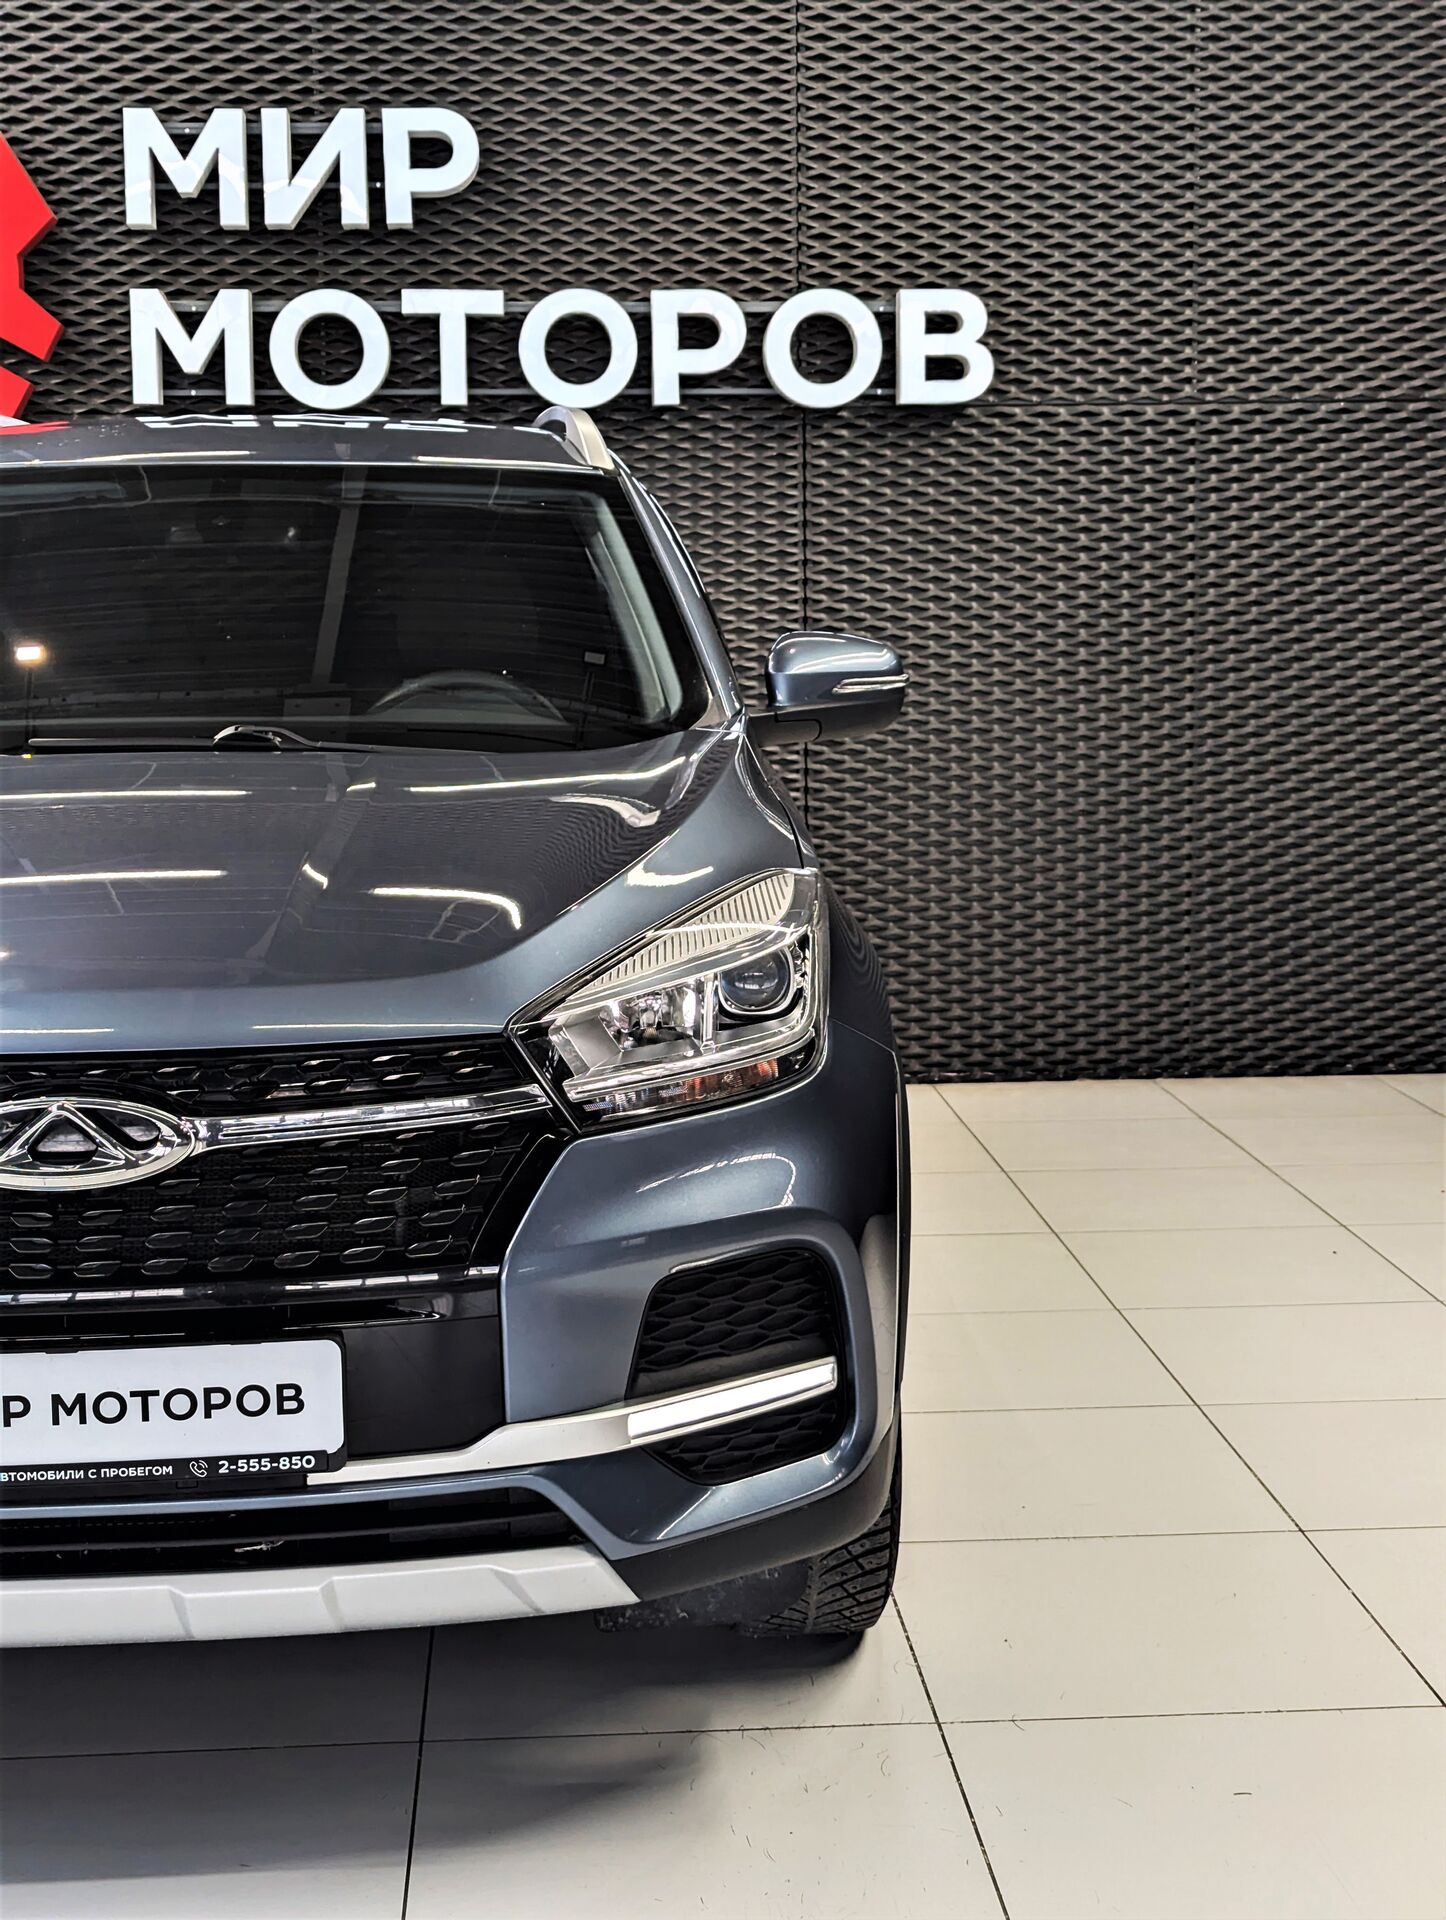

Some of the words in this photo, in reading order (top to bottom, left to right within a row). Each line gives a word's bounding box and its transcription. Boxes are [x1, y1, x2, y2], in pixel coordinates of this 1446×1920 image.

[122, 107, 480, 230] МИР
[129, 288, 995, 409] МОТОРОВ
[51, 1383, 305, 1426] МОТОРОВ
[88, 1469, 97, 1479] С
[101, 1465, 173, 1478] ПРОБЕГОМ
[218, 1455, 316, 1474] 2-555-850
